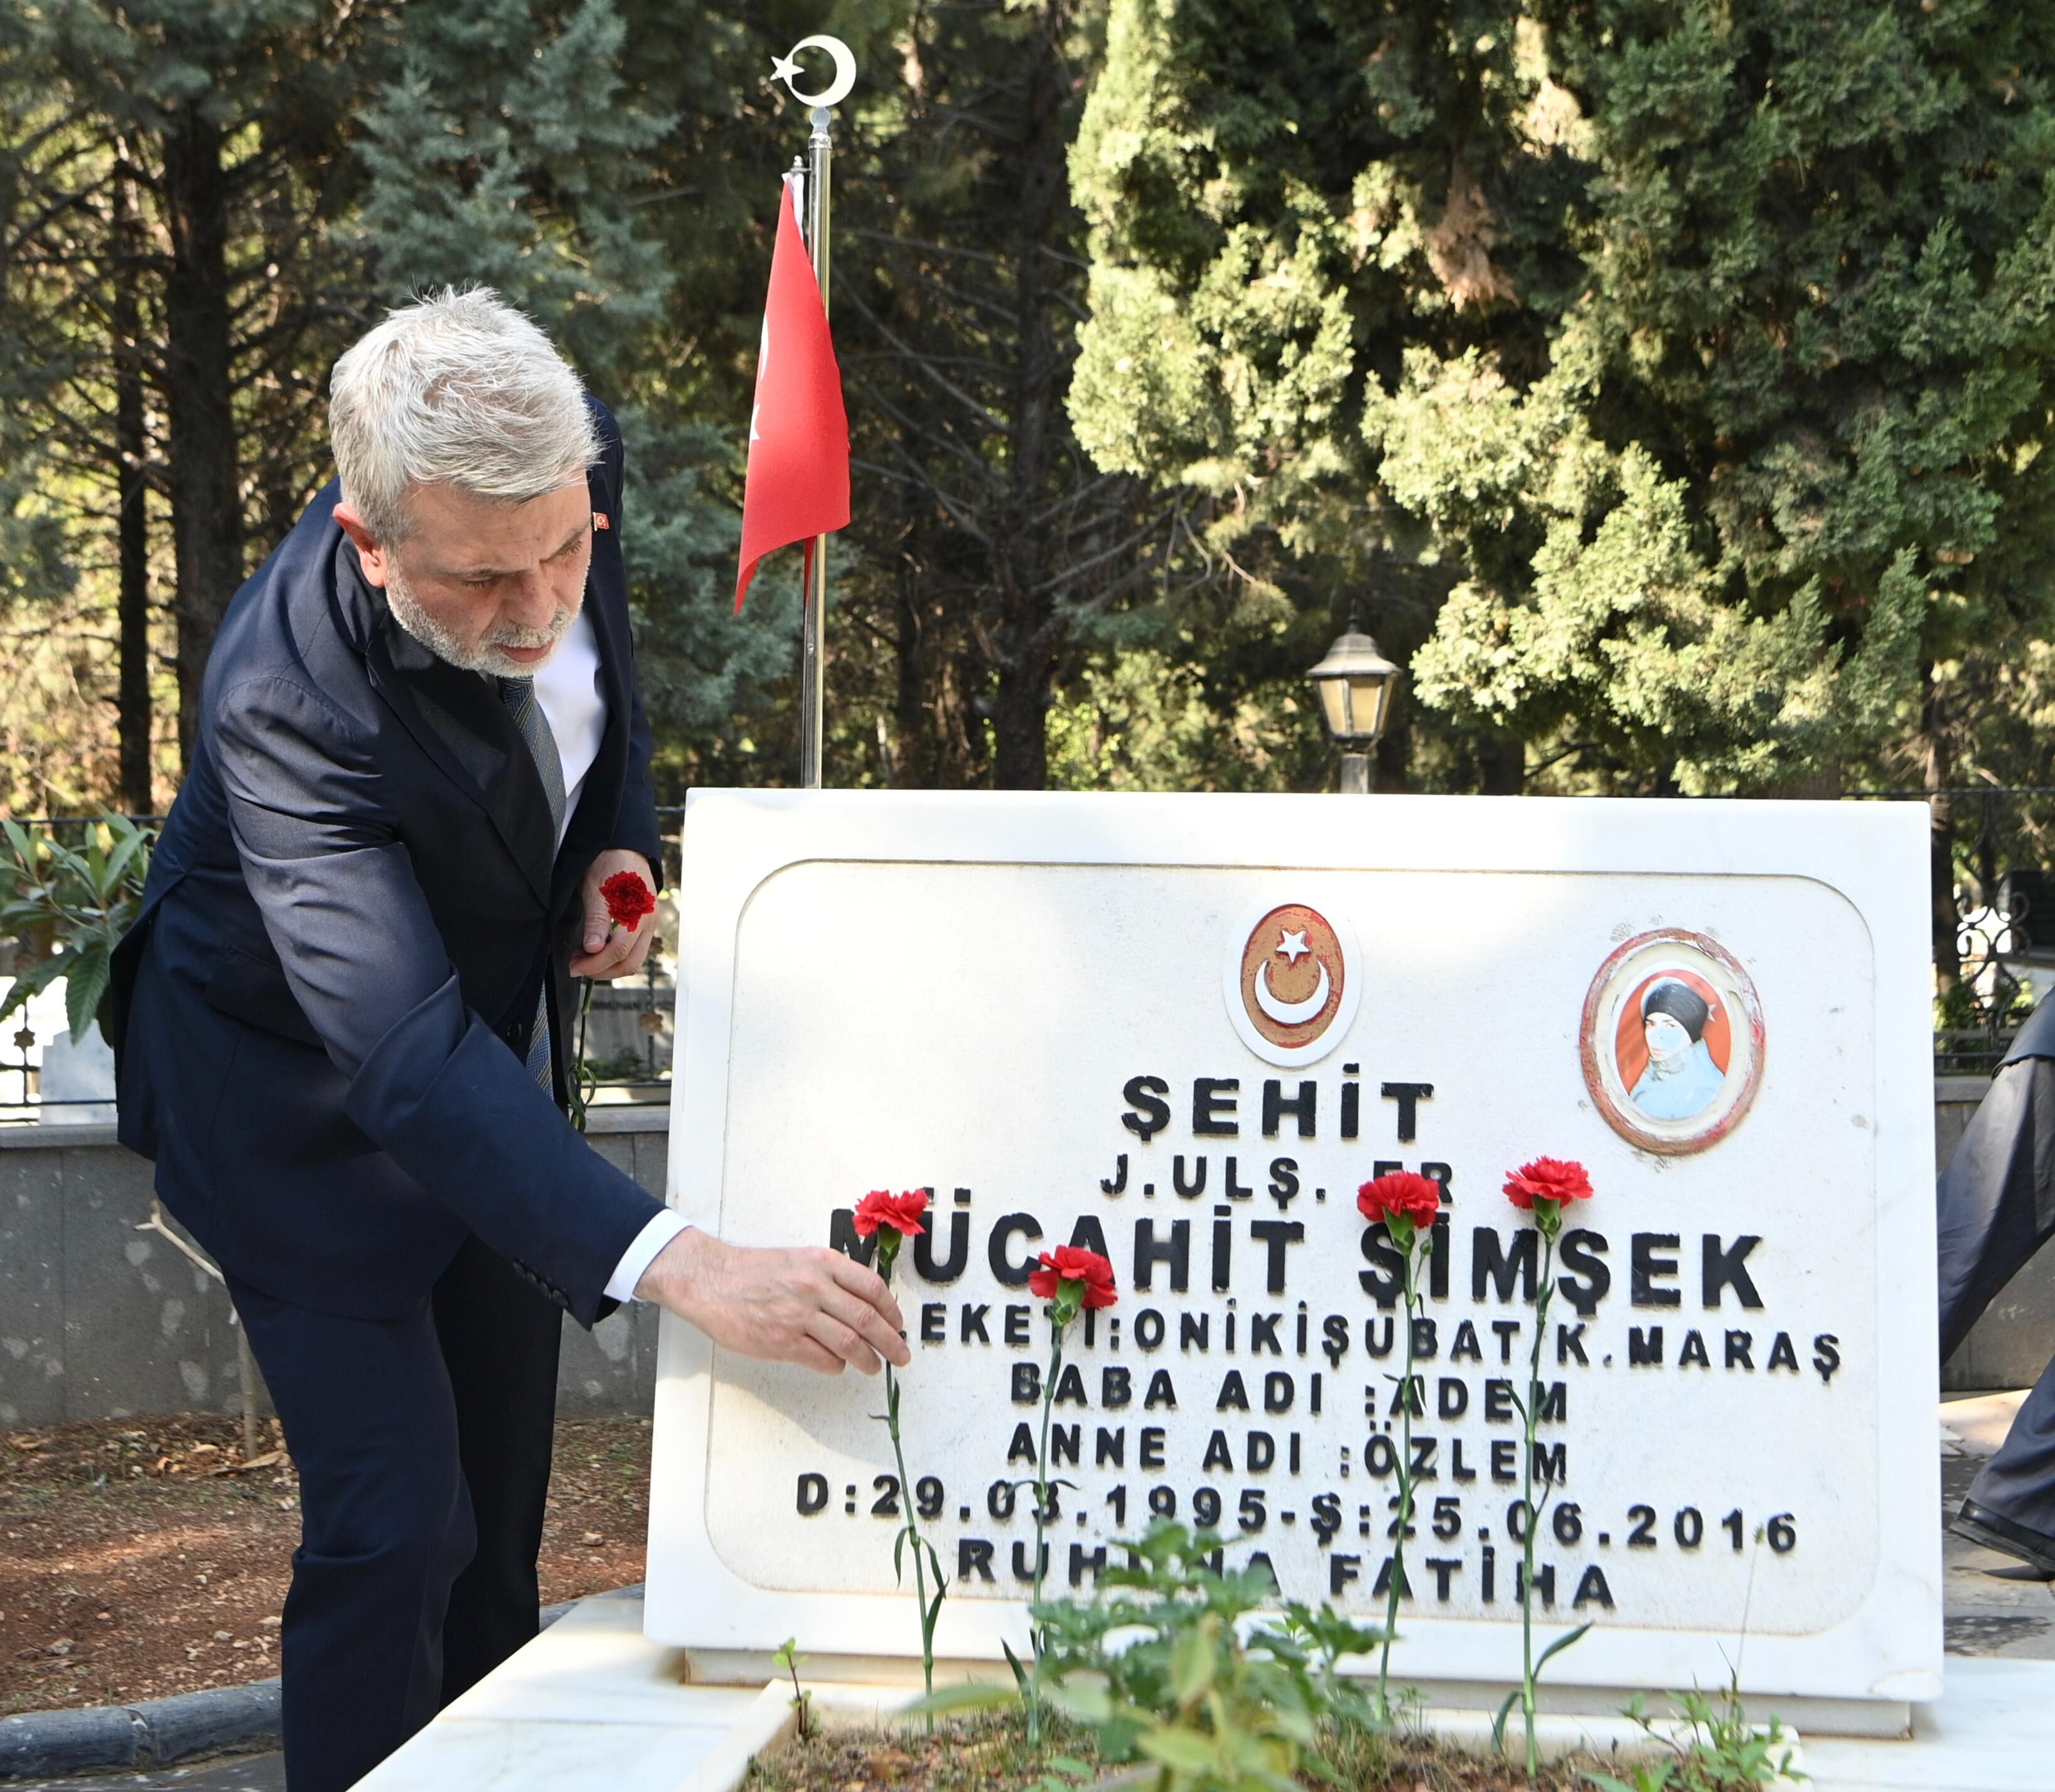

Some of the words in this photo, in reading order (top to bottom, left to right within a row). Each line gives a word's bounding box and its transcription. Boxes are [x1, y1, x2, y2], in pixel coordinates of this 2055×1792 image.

[1121, 1063, 1434, 1142] ŞEHİT
[1100, 1154, 1326, 1210] J.ULŞ.
[1358, 1212, 1764, 1316] ŞİMŞEK
[1011, 1362, 1177, 1408] BABA
[1216, 1370, 1321, 1414] ADI
[1007, 1422, 1166, 1468] ANNE
[1203, 1430, 1301, 1474] ADI
[1330, 1547, 1614, 1609] FATİHA
